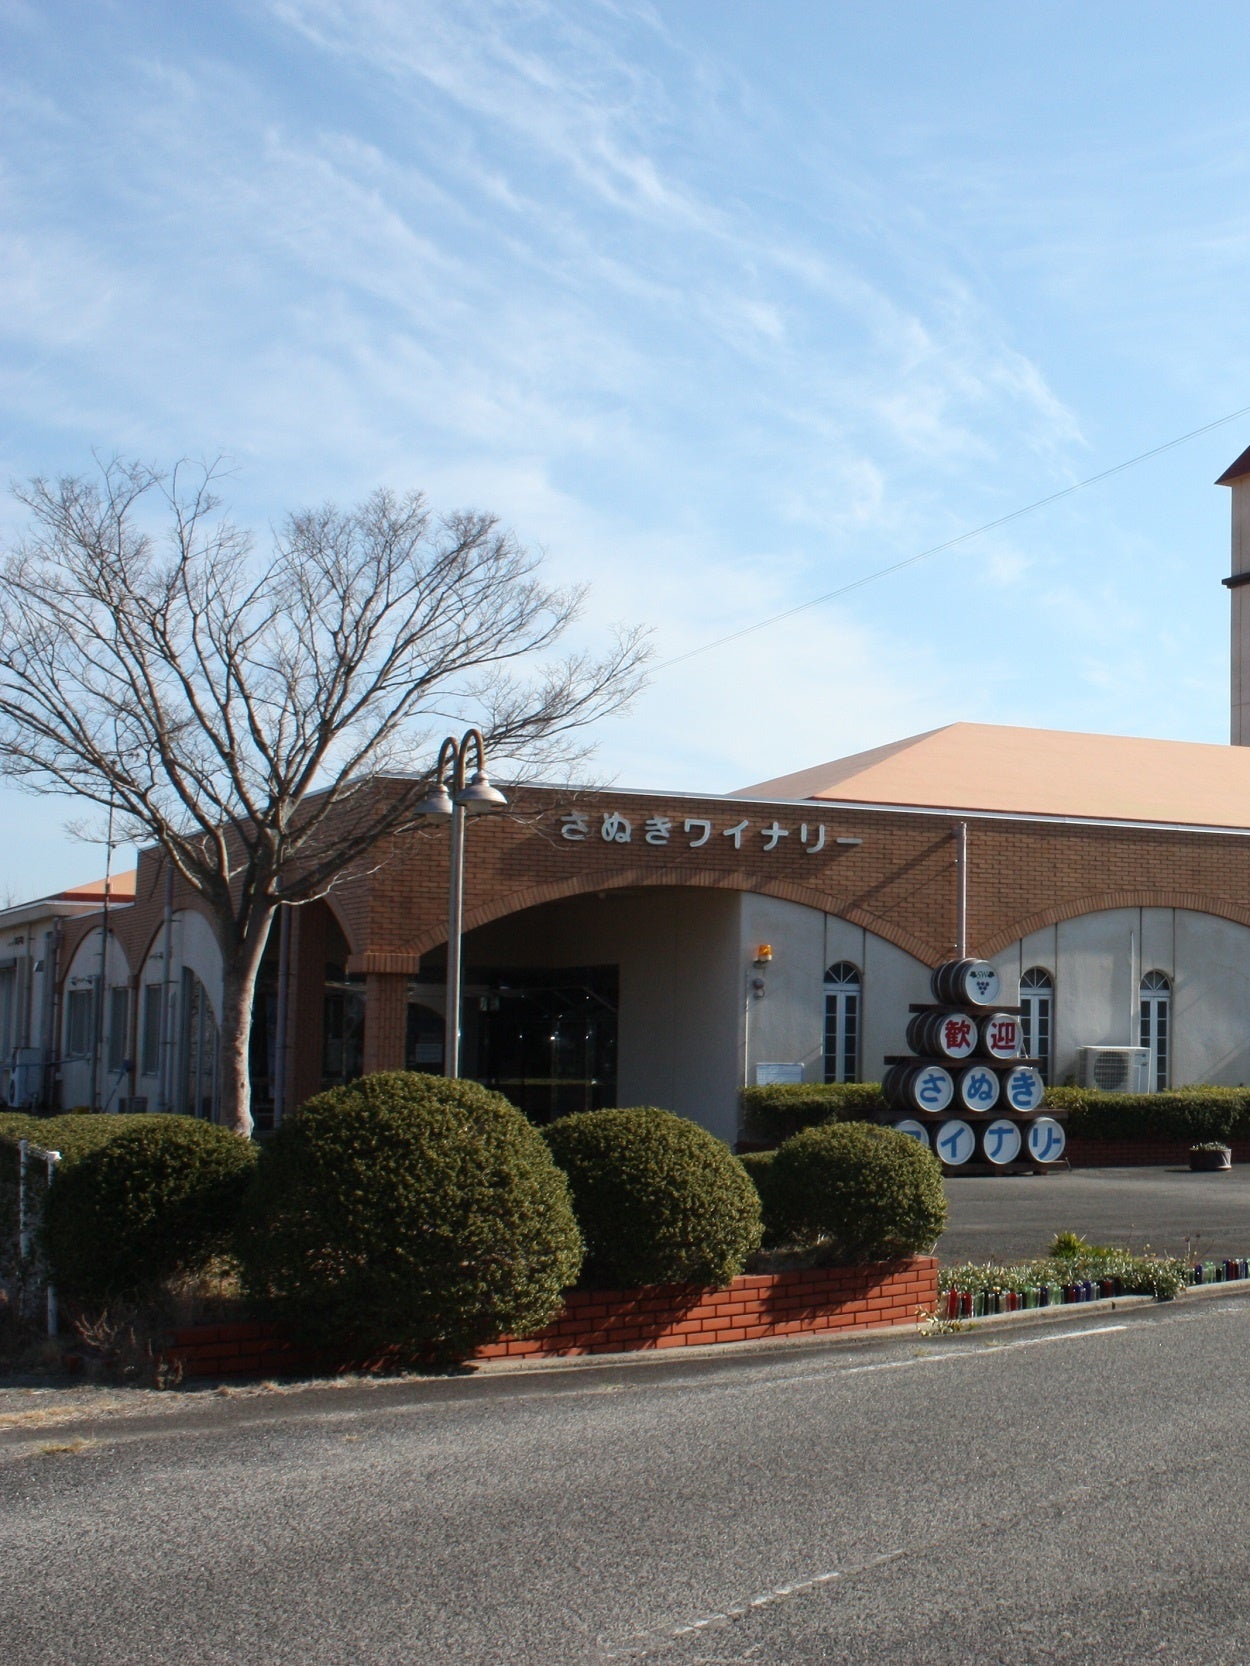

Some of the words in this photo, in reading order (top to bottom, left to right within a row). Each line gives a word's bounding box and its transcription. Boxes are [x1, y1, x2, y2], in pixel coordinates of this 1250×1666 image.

[560, 811, 863, 853] さぬきワイナリー
[945, 1019, 1016, 1050] 歓迎
[919, 1071, 1036, 1107] さぬき
